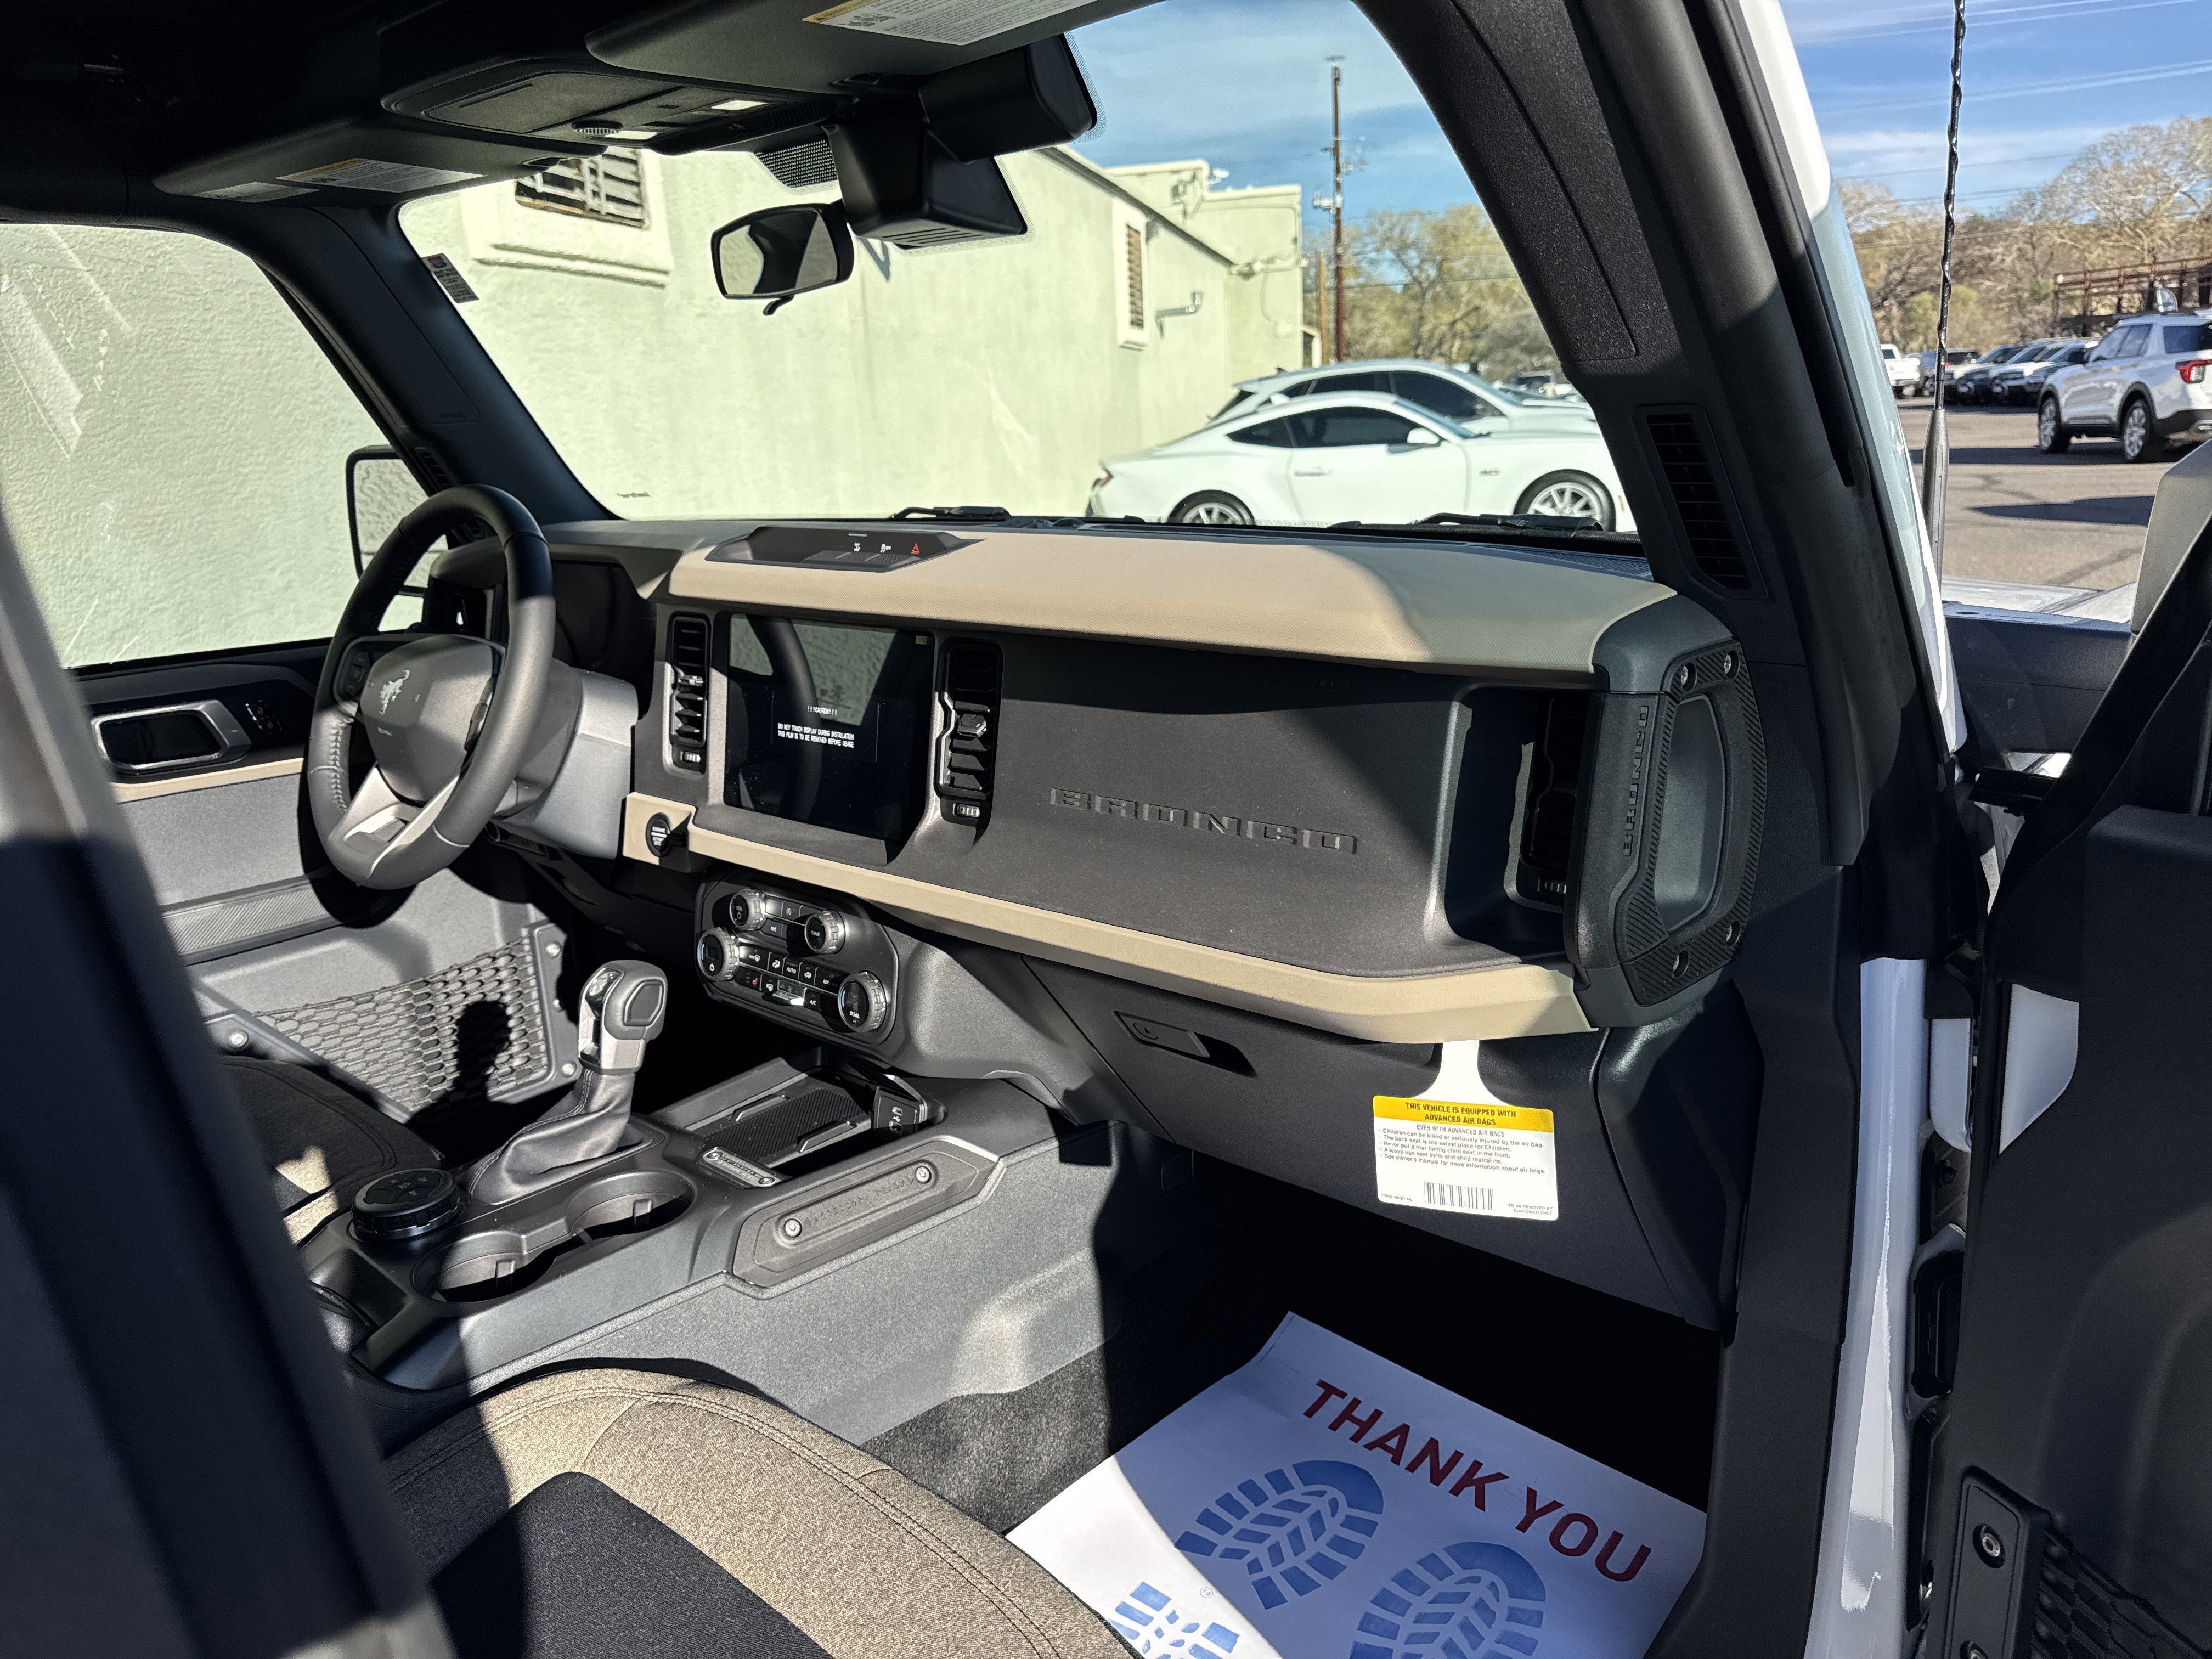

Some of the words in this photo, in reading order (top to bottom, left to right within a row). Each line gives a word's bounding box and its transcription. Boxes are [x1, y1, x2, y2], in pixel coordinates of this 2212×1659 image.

[831, 731, 854, 740] INSTALLATION
[1623, 705, 1649, 856] BRONCO
[1050, 788, 1358, 855] BRONCO
[849, 1011, 860, 1019] DUAL
[1405, 1102, 1421, 1110] THIS
[1423, 1104, 1451, 1113] VEHICLE
[1461, 1107, 1496, 1116] EQUIPPED
[1425, 1113, 1461, 1123] ADVANCED
[1463, 1116, 1475, 1125] AIR
[1303, 1379, 1510, 1512] THANK
[1515, 1486, 1652, 1582] YOU
